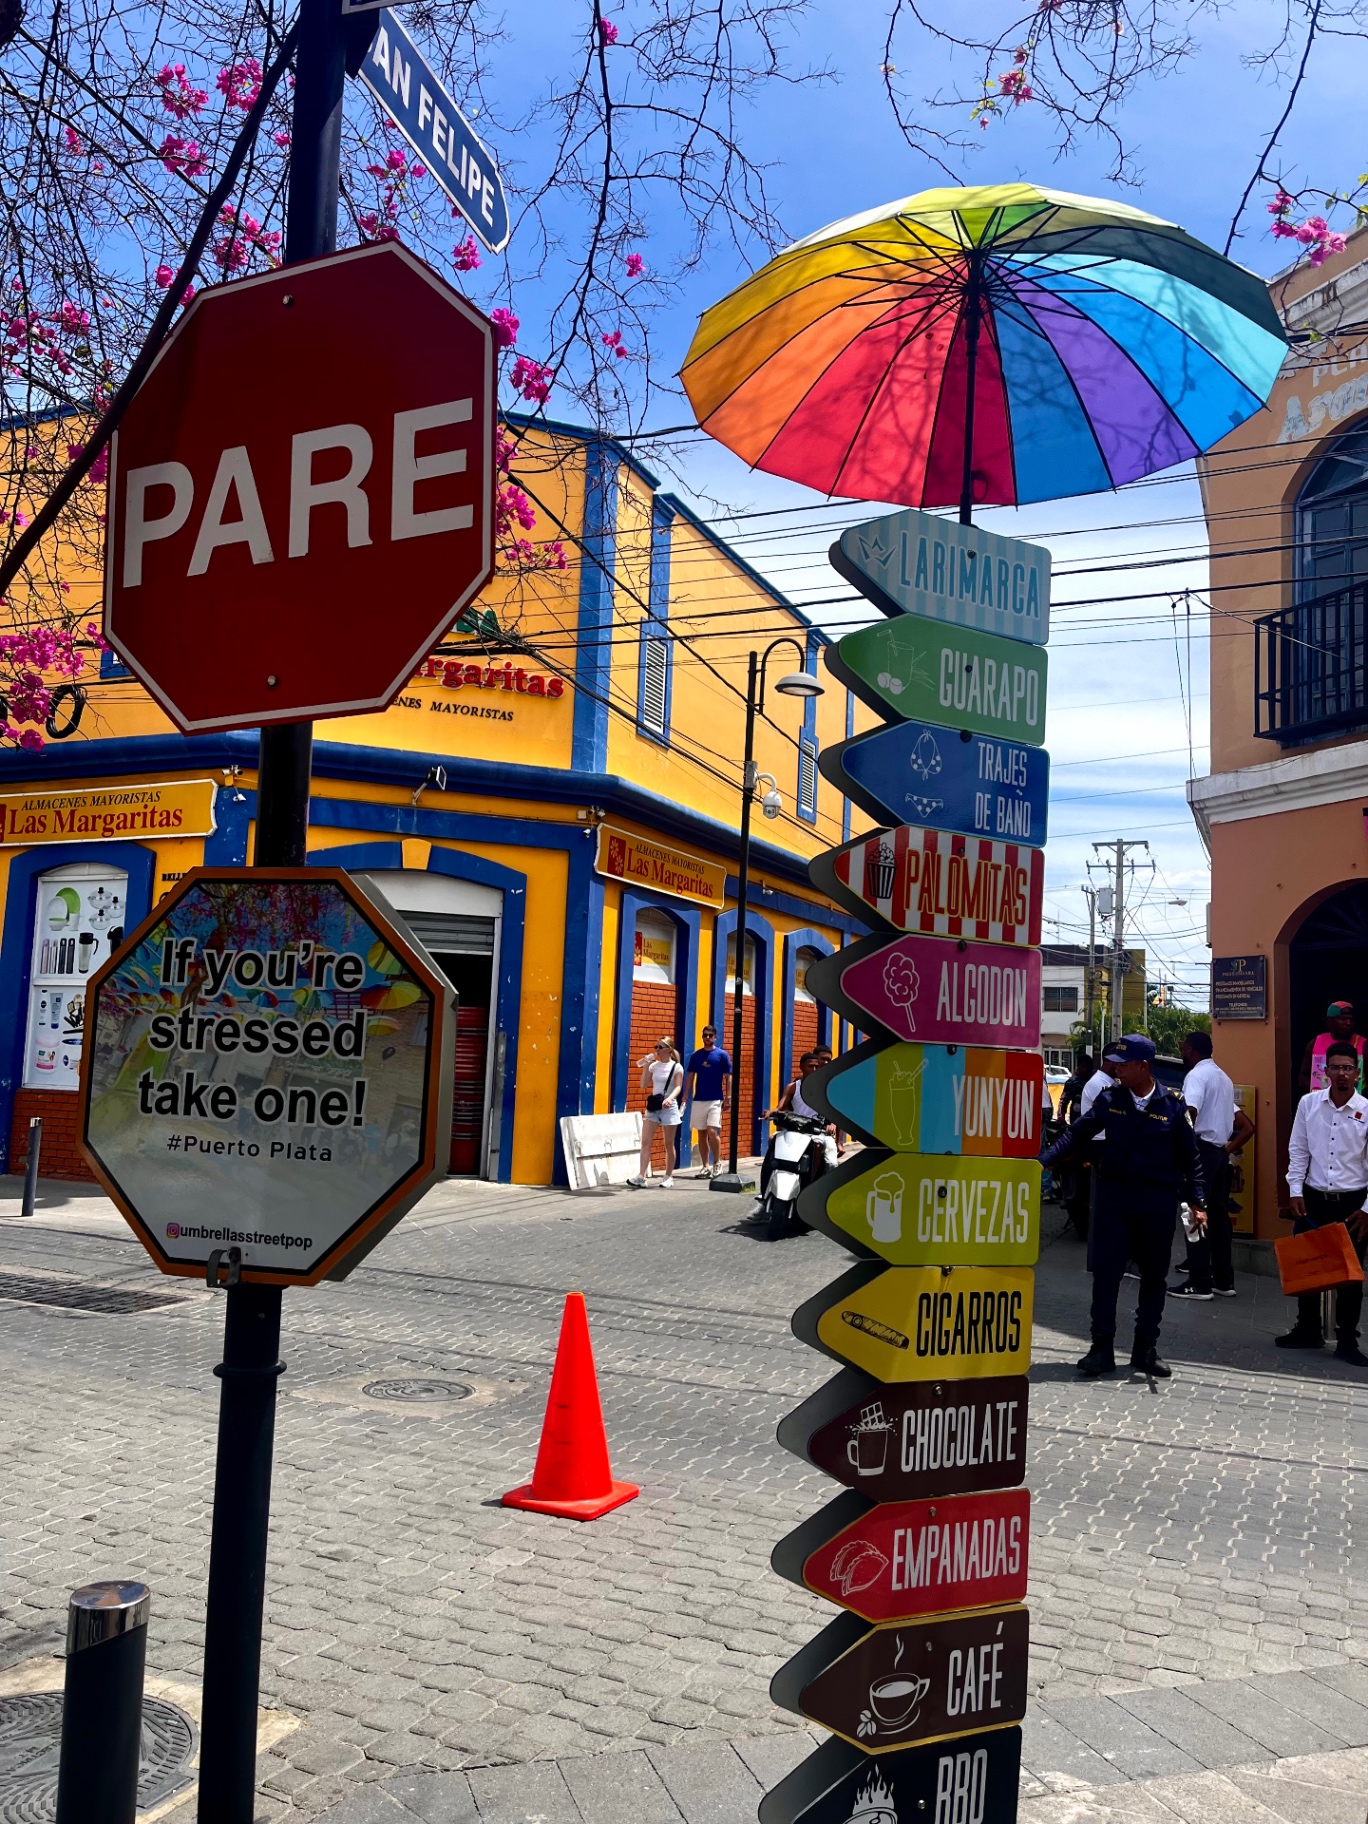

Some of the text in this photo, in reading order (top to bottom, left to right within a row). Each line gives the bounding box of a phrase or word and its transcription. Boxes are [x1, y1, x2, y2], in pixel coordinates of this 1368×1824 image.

[368, 25, 495, 228] AN FELIPE
[123, 397, 474, 588] PARE
[900, 531, 1040, 619] LARIMARCA
[415, 657, 564, 698] rgaritas
[938, 647, 1039, 726] GUARAPO
[430, 701, 514, 721] MAYORISTAS
[977, 742, 1027, 788] TRAJES
[8, 804, 183, 838] Las Margaritas
[21, 791, 161, 811] ALMACENES MAYORISTAS
[975, 789, 1031, 838] DE BAÑO
[626, 848, 713, 898] Las Margaritas
[635, 844, 705, 874] ALMACENES MAYORISTAS
[904, 848, 1027, 926] PALOMITAS
[162, 938, 363, 995] If you're
[936, 961, 1027, 1027] ALGODON
[149, 1005, 366, 1057] stressed
[138, 1072, 366, 1127] take one!
[952, 1074, 1034, 1139] YUNYUN
[167, 1134, 333, 1162] #Puerto Plata
[180, 1224, 313, 1250] umbrellasstreetpop
[917, 1178, 1029, 1244] CERVEZAS
[916, 1290, 1022, 1357] CIGARROS
[901, 1401, 1018, 1473] CHOCOLATE
[891, 1515, 1021, 1591] EMPANADAS
[946, 1621, 1004, 1716] CAFÉ
